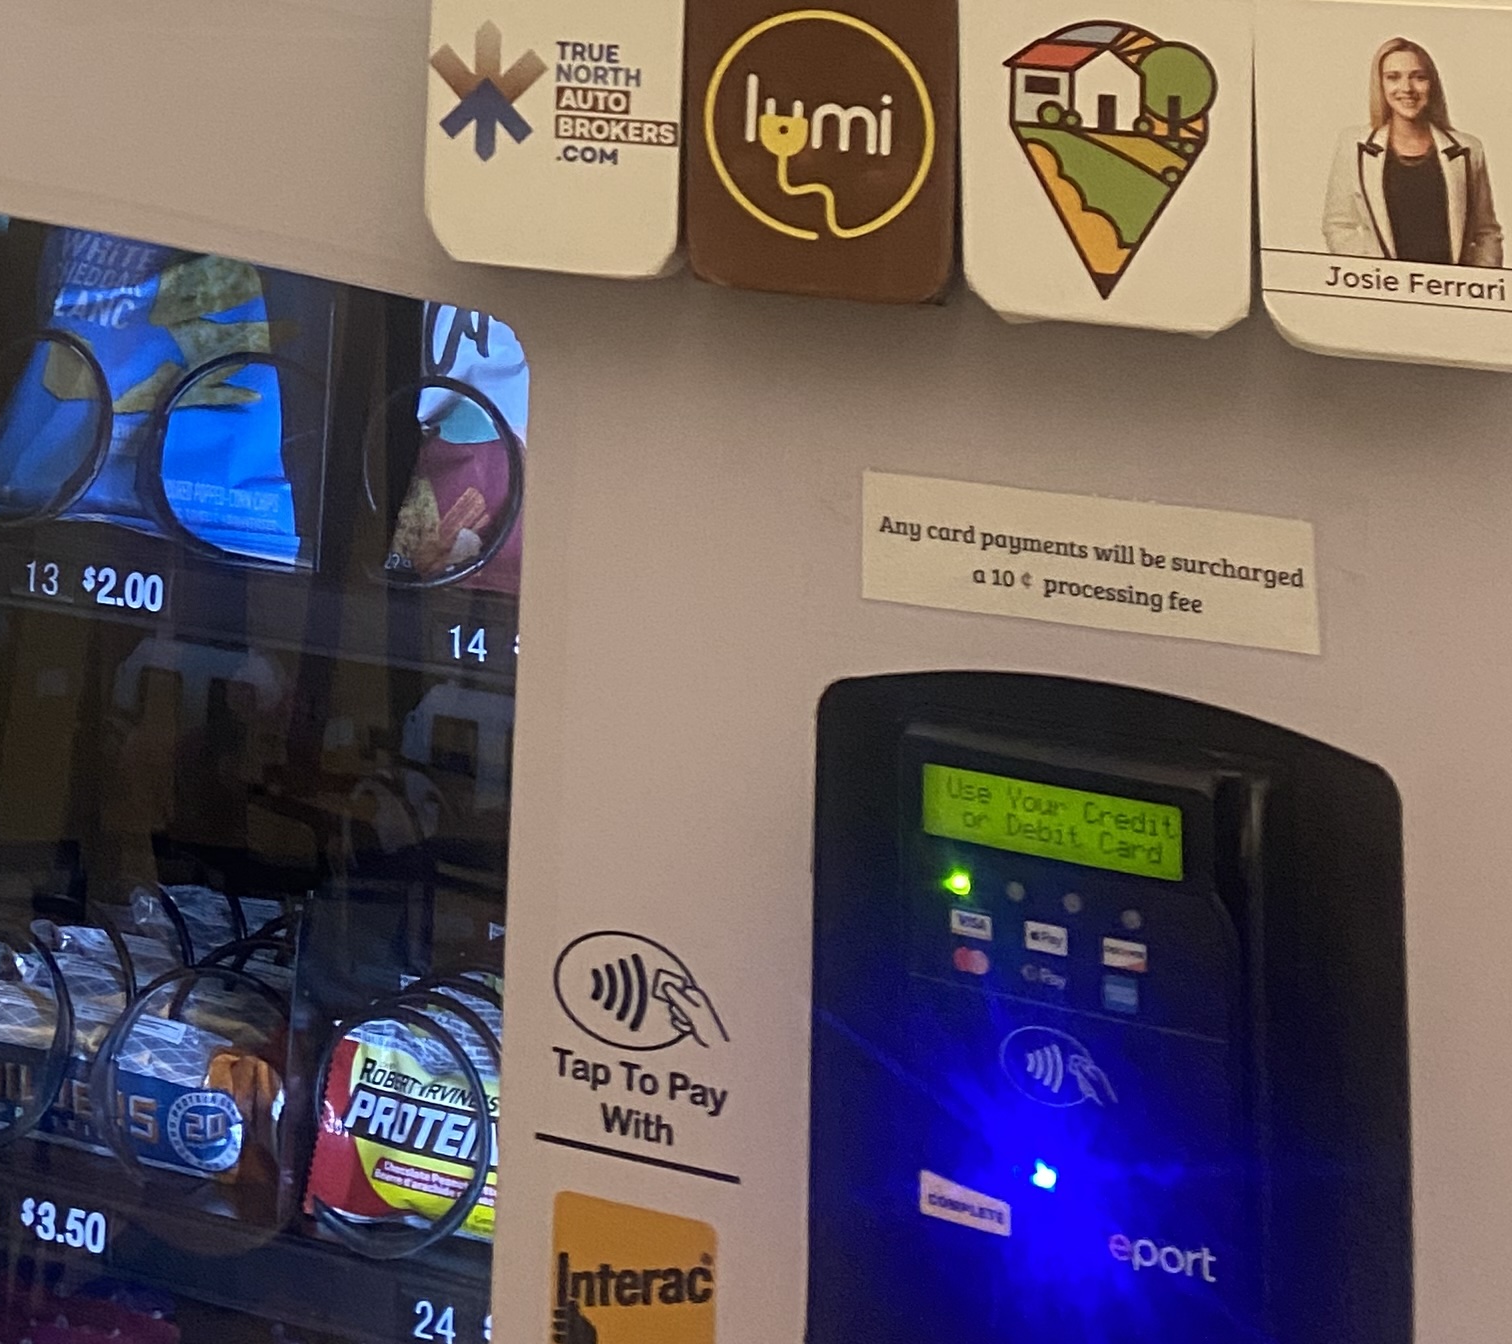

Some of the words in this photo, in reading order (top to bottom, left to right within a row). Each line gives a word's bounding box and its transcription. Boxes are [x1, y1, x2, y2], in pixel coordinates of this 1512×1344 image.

[555, 41, 621, 64] TRUE
[555, 64, 642, 88] NORTH
[559, 89, 628, 113] AUTO
[744, 73, 893, 157] lumi
[558, 117, 676, 144] BROKERS
[555, 145, 619, 165] .COM
[1325, 265, 1400, 292] Josie
[1408, 273, 1506, 302] Ferrari
[52, 286, 136, 330] LANC
[879, 515, 922, 542] Any
[927, 522, 976, 545] card
[981, 529, 1089, 560] payments
[1093, 543, 1136, 566] will
[1140, 547, 1166, 570] be
[1171, 555, 1304, 589] surcharged
[25, 560, 61, 597] 13
[81, 565, 166, 615] $2.00
[972, 569, 987, 584] a
[991, 568, 1016, 588] 10
[1043, 574, 1164, 612] processing
[1168, 590, 1204, 614] fee
[448, 624, 488, 663] 14
[946, 774, 993, 805] Use
[1007, 784, 1067, 818] Your
[1082, 800, 1178, 840] Credit
[962, 811, 990, 829] or
[1006, 812, 1082, 847] Debit
[1099, 830, 1164, 865] Card
[359, 1057, 423, 1095] ROBERT
[551, 1045, 612, 1091] Tap
[619, 1060, 659, 1096] To
[668, 1071, 729, 1117] Pay
[184, 1111, 225, 1142] 20
[600, 1101, 675, 1146] With
[19, 1196, 107, 1254] $3.50
[557, 1251, 715, 1308] Interac
[1108, 1232, 1218, 1283] eport
[413, 1299, 457, 1344] 24
